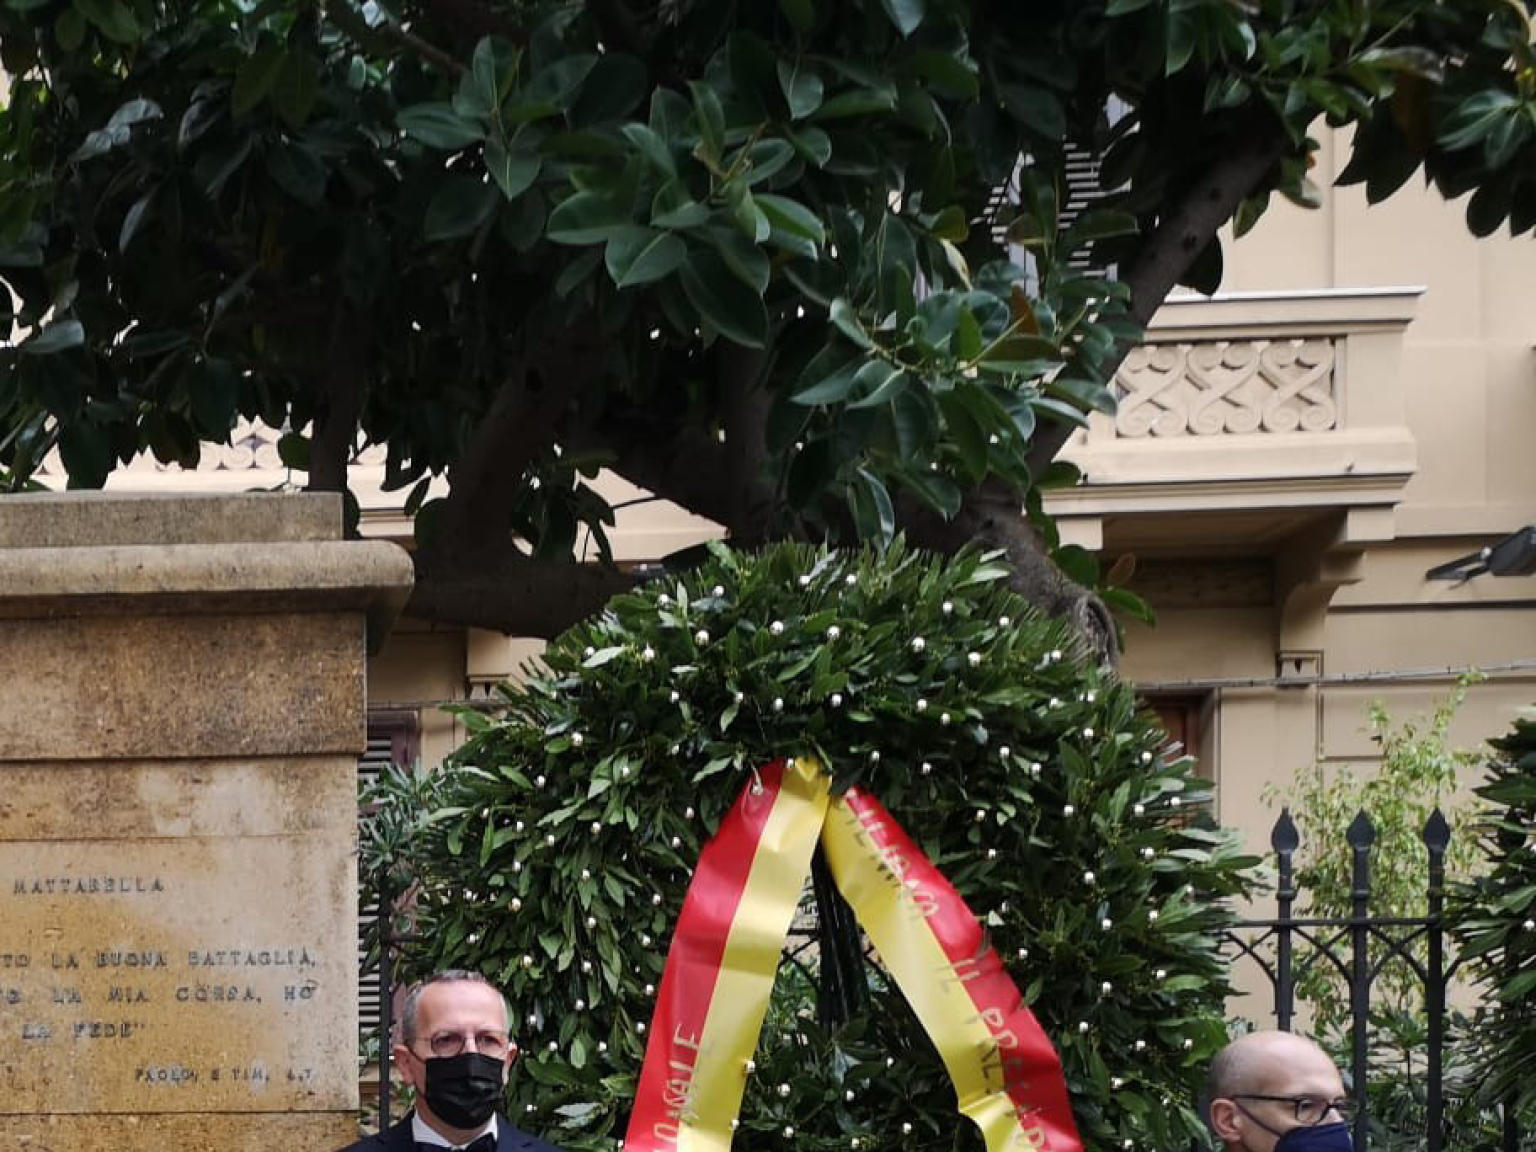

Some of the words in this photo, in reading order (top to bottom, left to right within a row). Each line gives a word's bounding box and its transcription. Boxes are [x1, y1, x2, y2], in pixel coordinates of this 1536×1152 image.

[13, 877, 163, 895] MATTARELLA
[52, 954, 79, 969] LA
[97, 952, 167, 967] BUONA
[188, 951, 315, 968] BATTAGLIA,
[54, 988, 82, 1003] LA
[109, 987, 148, 1003] MIA
[177, 986, 262, 1003] CORSA,
[22, 1024, 52, 1039] LA
